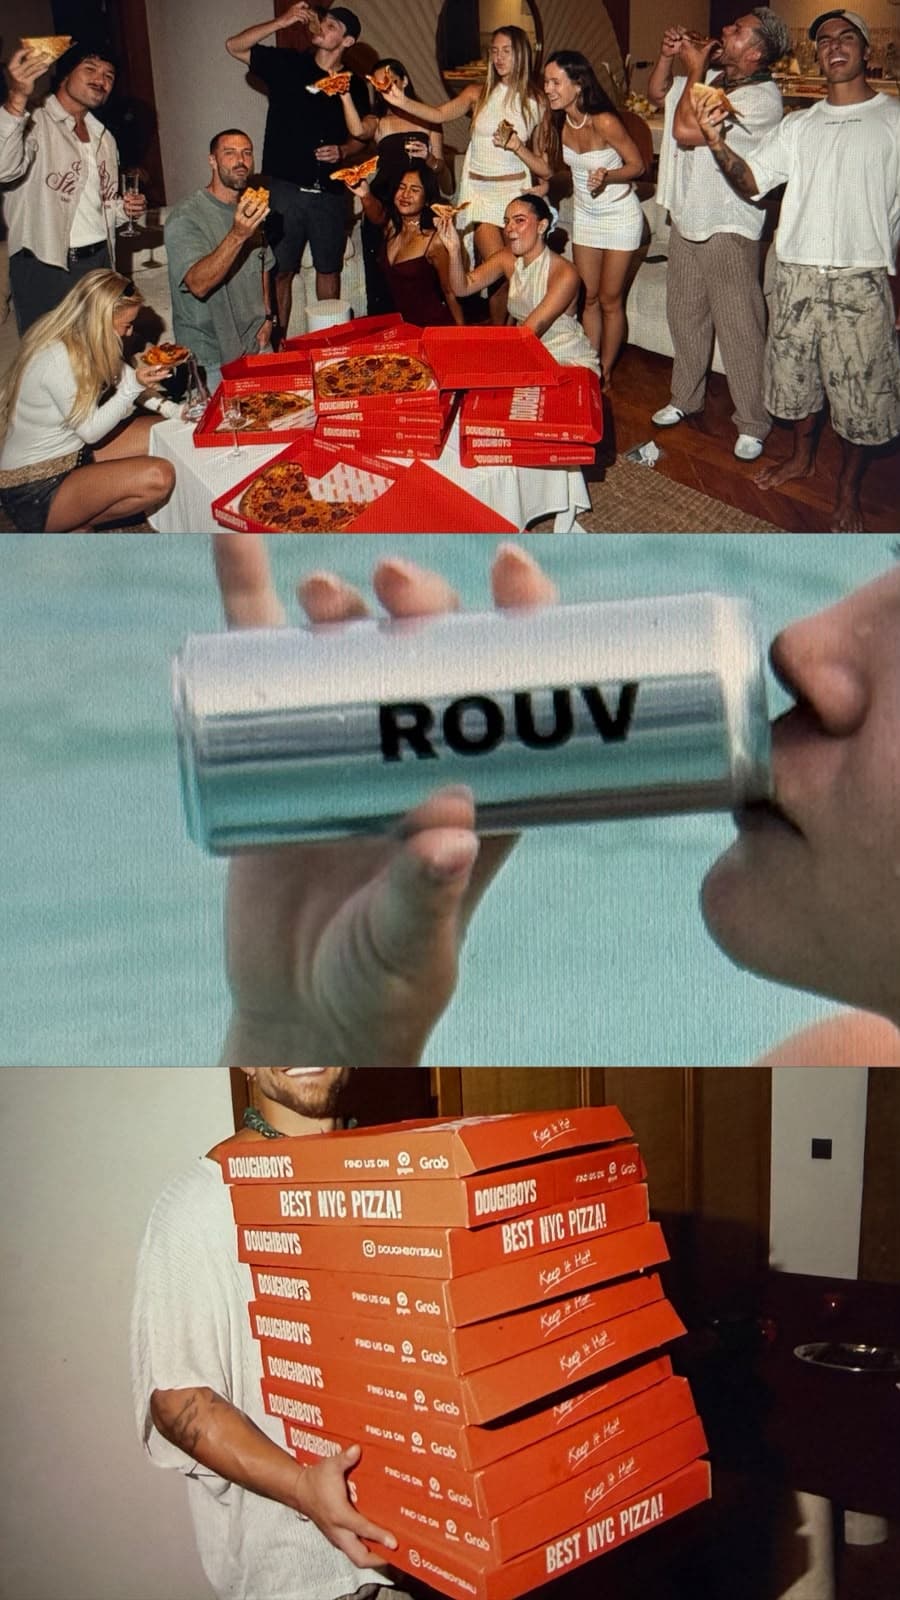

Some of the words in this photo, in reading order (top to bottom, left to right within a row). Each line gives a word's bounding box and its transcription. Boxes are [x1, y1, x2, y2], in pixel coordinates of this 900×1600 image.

[379, 682, 639, 762] ROUV
[228, 1156, 293, 1178] DOUGHBOYS
[419, 1155, 449, 1169] Grab
[280, 1191, 311, 1217] BEST
[318, 1191, 346, 1218] NYC
[351, 1190, 402, 1219] PIZZA!
[474, 1179, 537, 1216] DOUGHBOYS
[502, 1217, 534, 1254] BEST
[539, 1212, 565, 1244] NYC
[568, 1203, 607, 1237] PIZZA!
[244, 1230, 302, 1255] DOUGHBOYS
[257, 1273, 311, 1301] DOUGHBOYS
[539, 1267, 561, 1286] Keep
[415, 1300, 441, 1315] Grab
[540, 1309, 561, 1329] Keep
[255, 1315, 312, 1346] DOUGHBOYS
[421, 1349, 448, 1365] Grab
[267, 1356, 324, 1389] DOUGHBOYS
[268, 1393, 324, 1427] DOUGHBOYS
[433, 1399, 460, 1416] Grab
[430, 1442, 457, 1459] Grab
[568, 1441, 590, 1463] Keep
[447, 1489, 472, 1508] Grab
[584, 1482, 605, 1504] Keep
[464, 1532, 490, 1551] Grab
[546, 1531, 581, 1574] BEST
[587, 1516, 615, 1553] NYC
[620, 1493, 663, 1536] PIZZA!
